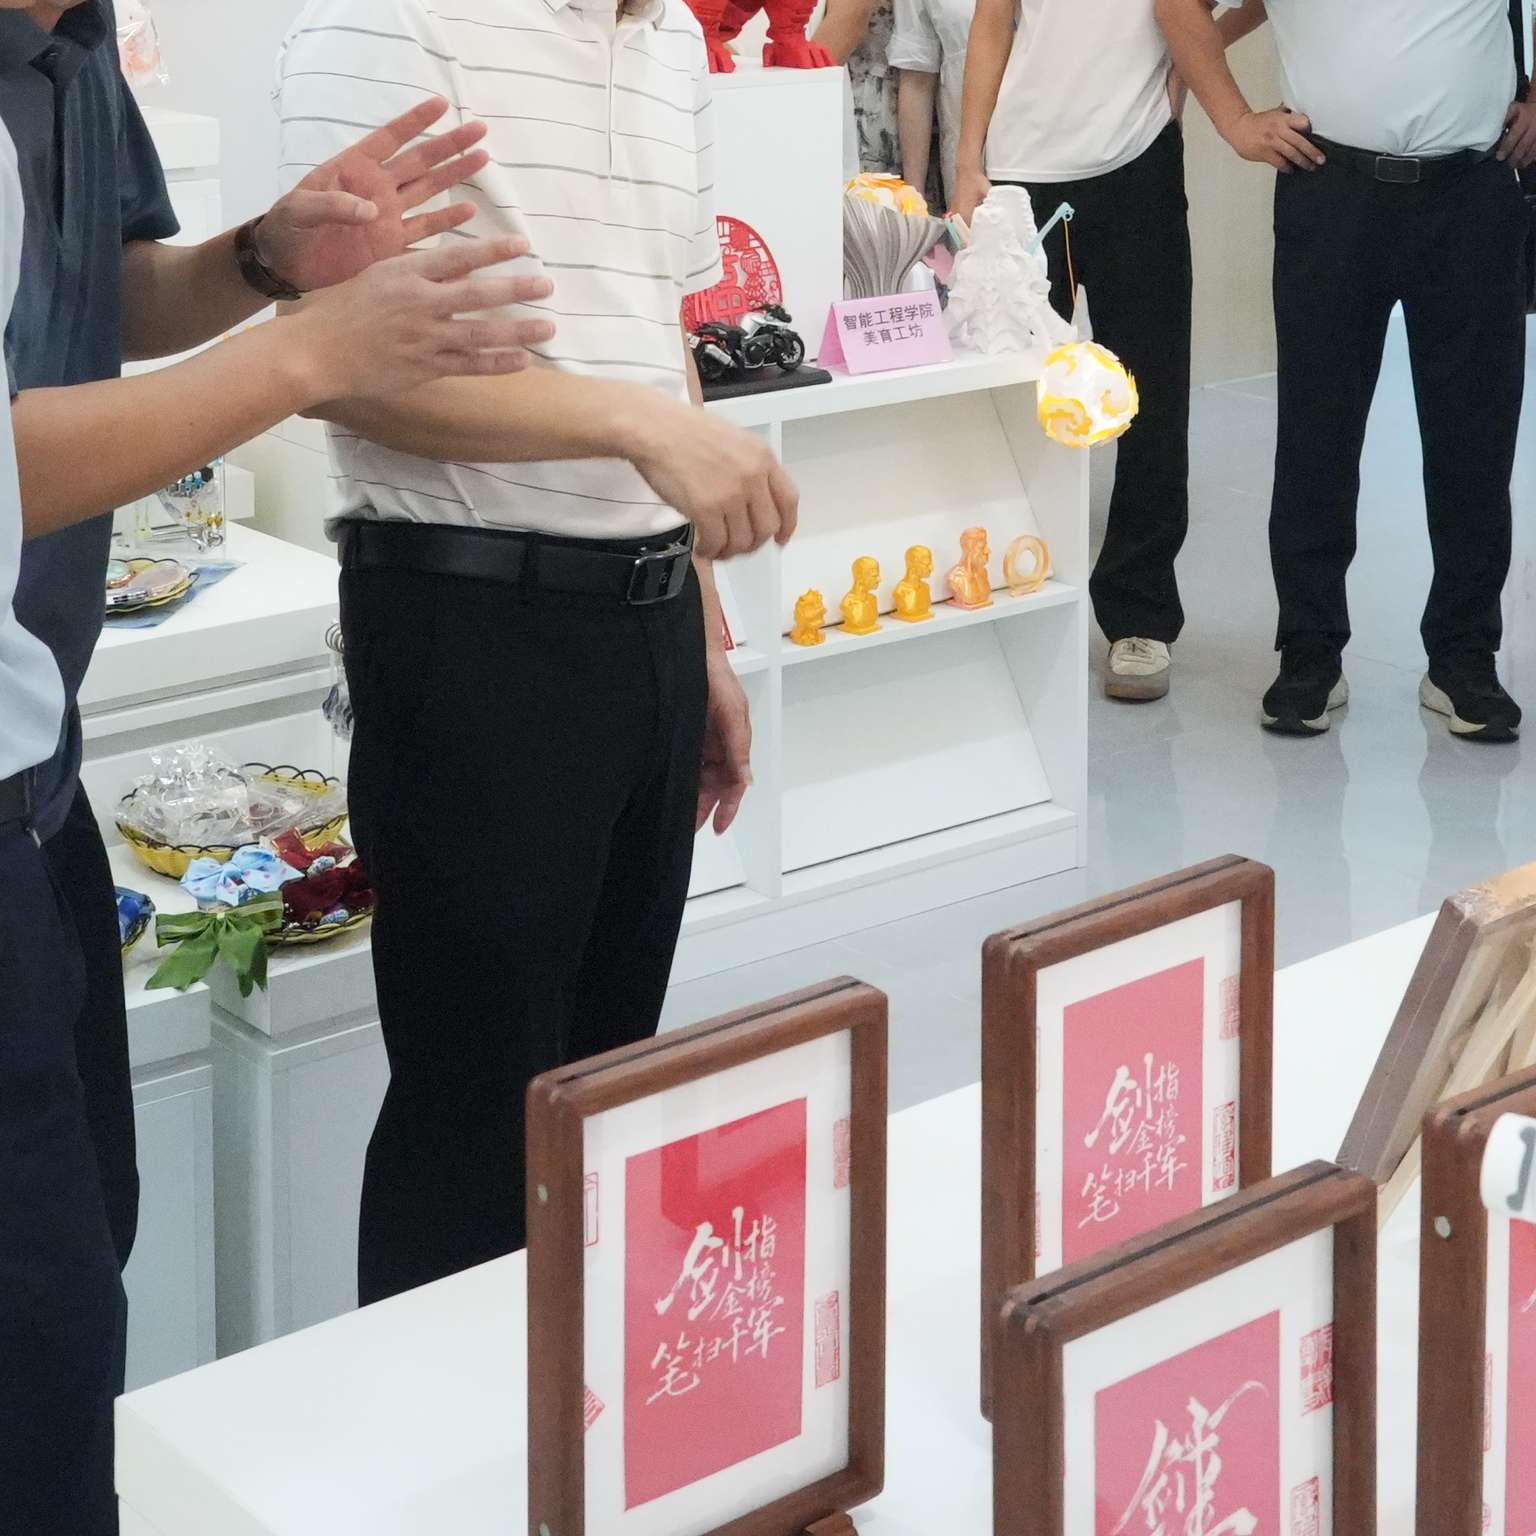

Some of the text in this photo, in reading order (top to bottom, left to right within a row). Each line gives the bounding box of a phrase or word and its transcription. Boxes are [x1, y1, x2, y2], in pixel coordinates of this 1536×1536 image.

[842, 302, 935, 332] 智能工程学院
[863, 324, 924, 347] 美育工坊
